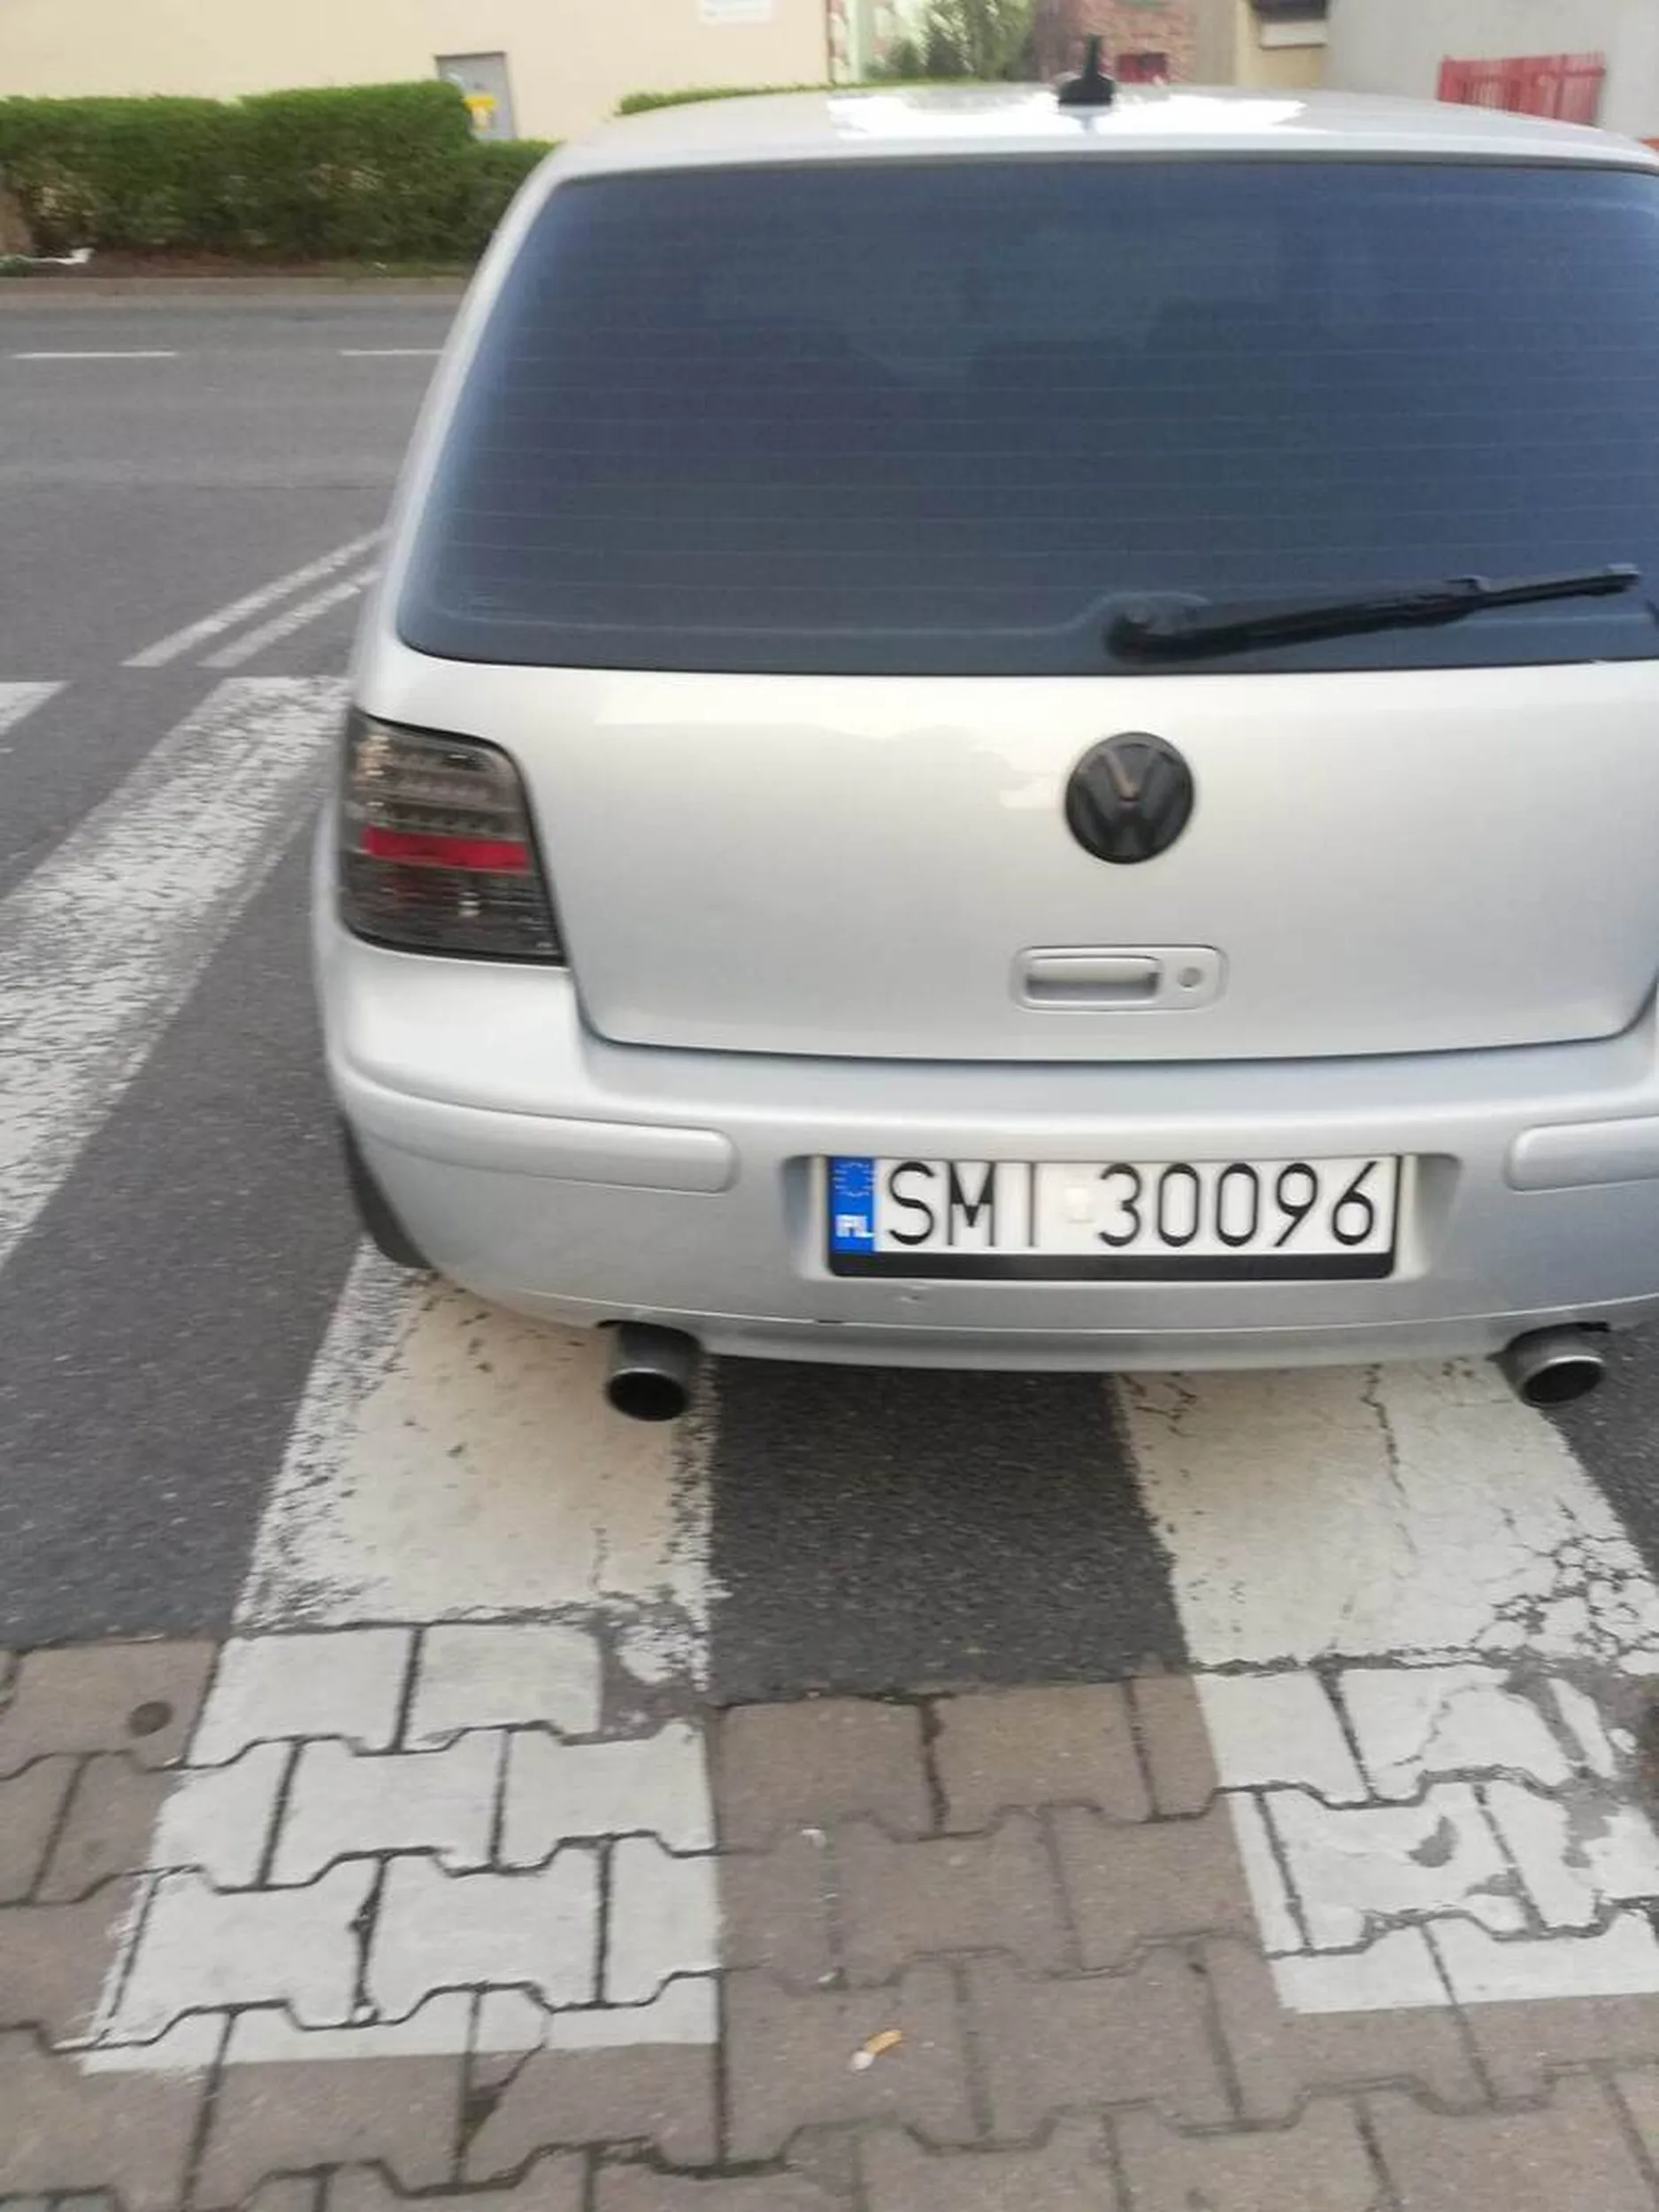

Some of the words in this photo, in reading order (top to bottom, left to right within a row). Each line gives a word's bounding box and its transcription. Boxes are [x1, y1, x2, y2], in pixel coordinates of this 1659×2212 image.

[835, 1214, 874, 1237] PL
[889, 1161, 1034, 1247] SMI
[1098, 1161, 1378, 1247] 30096
